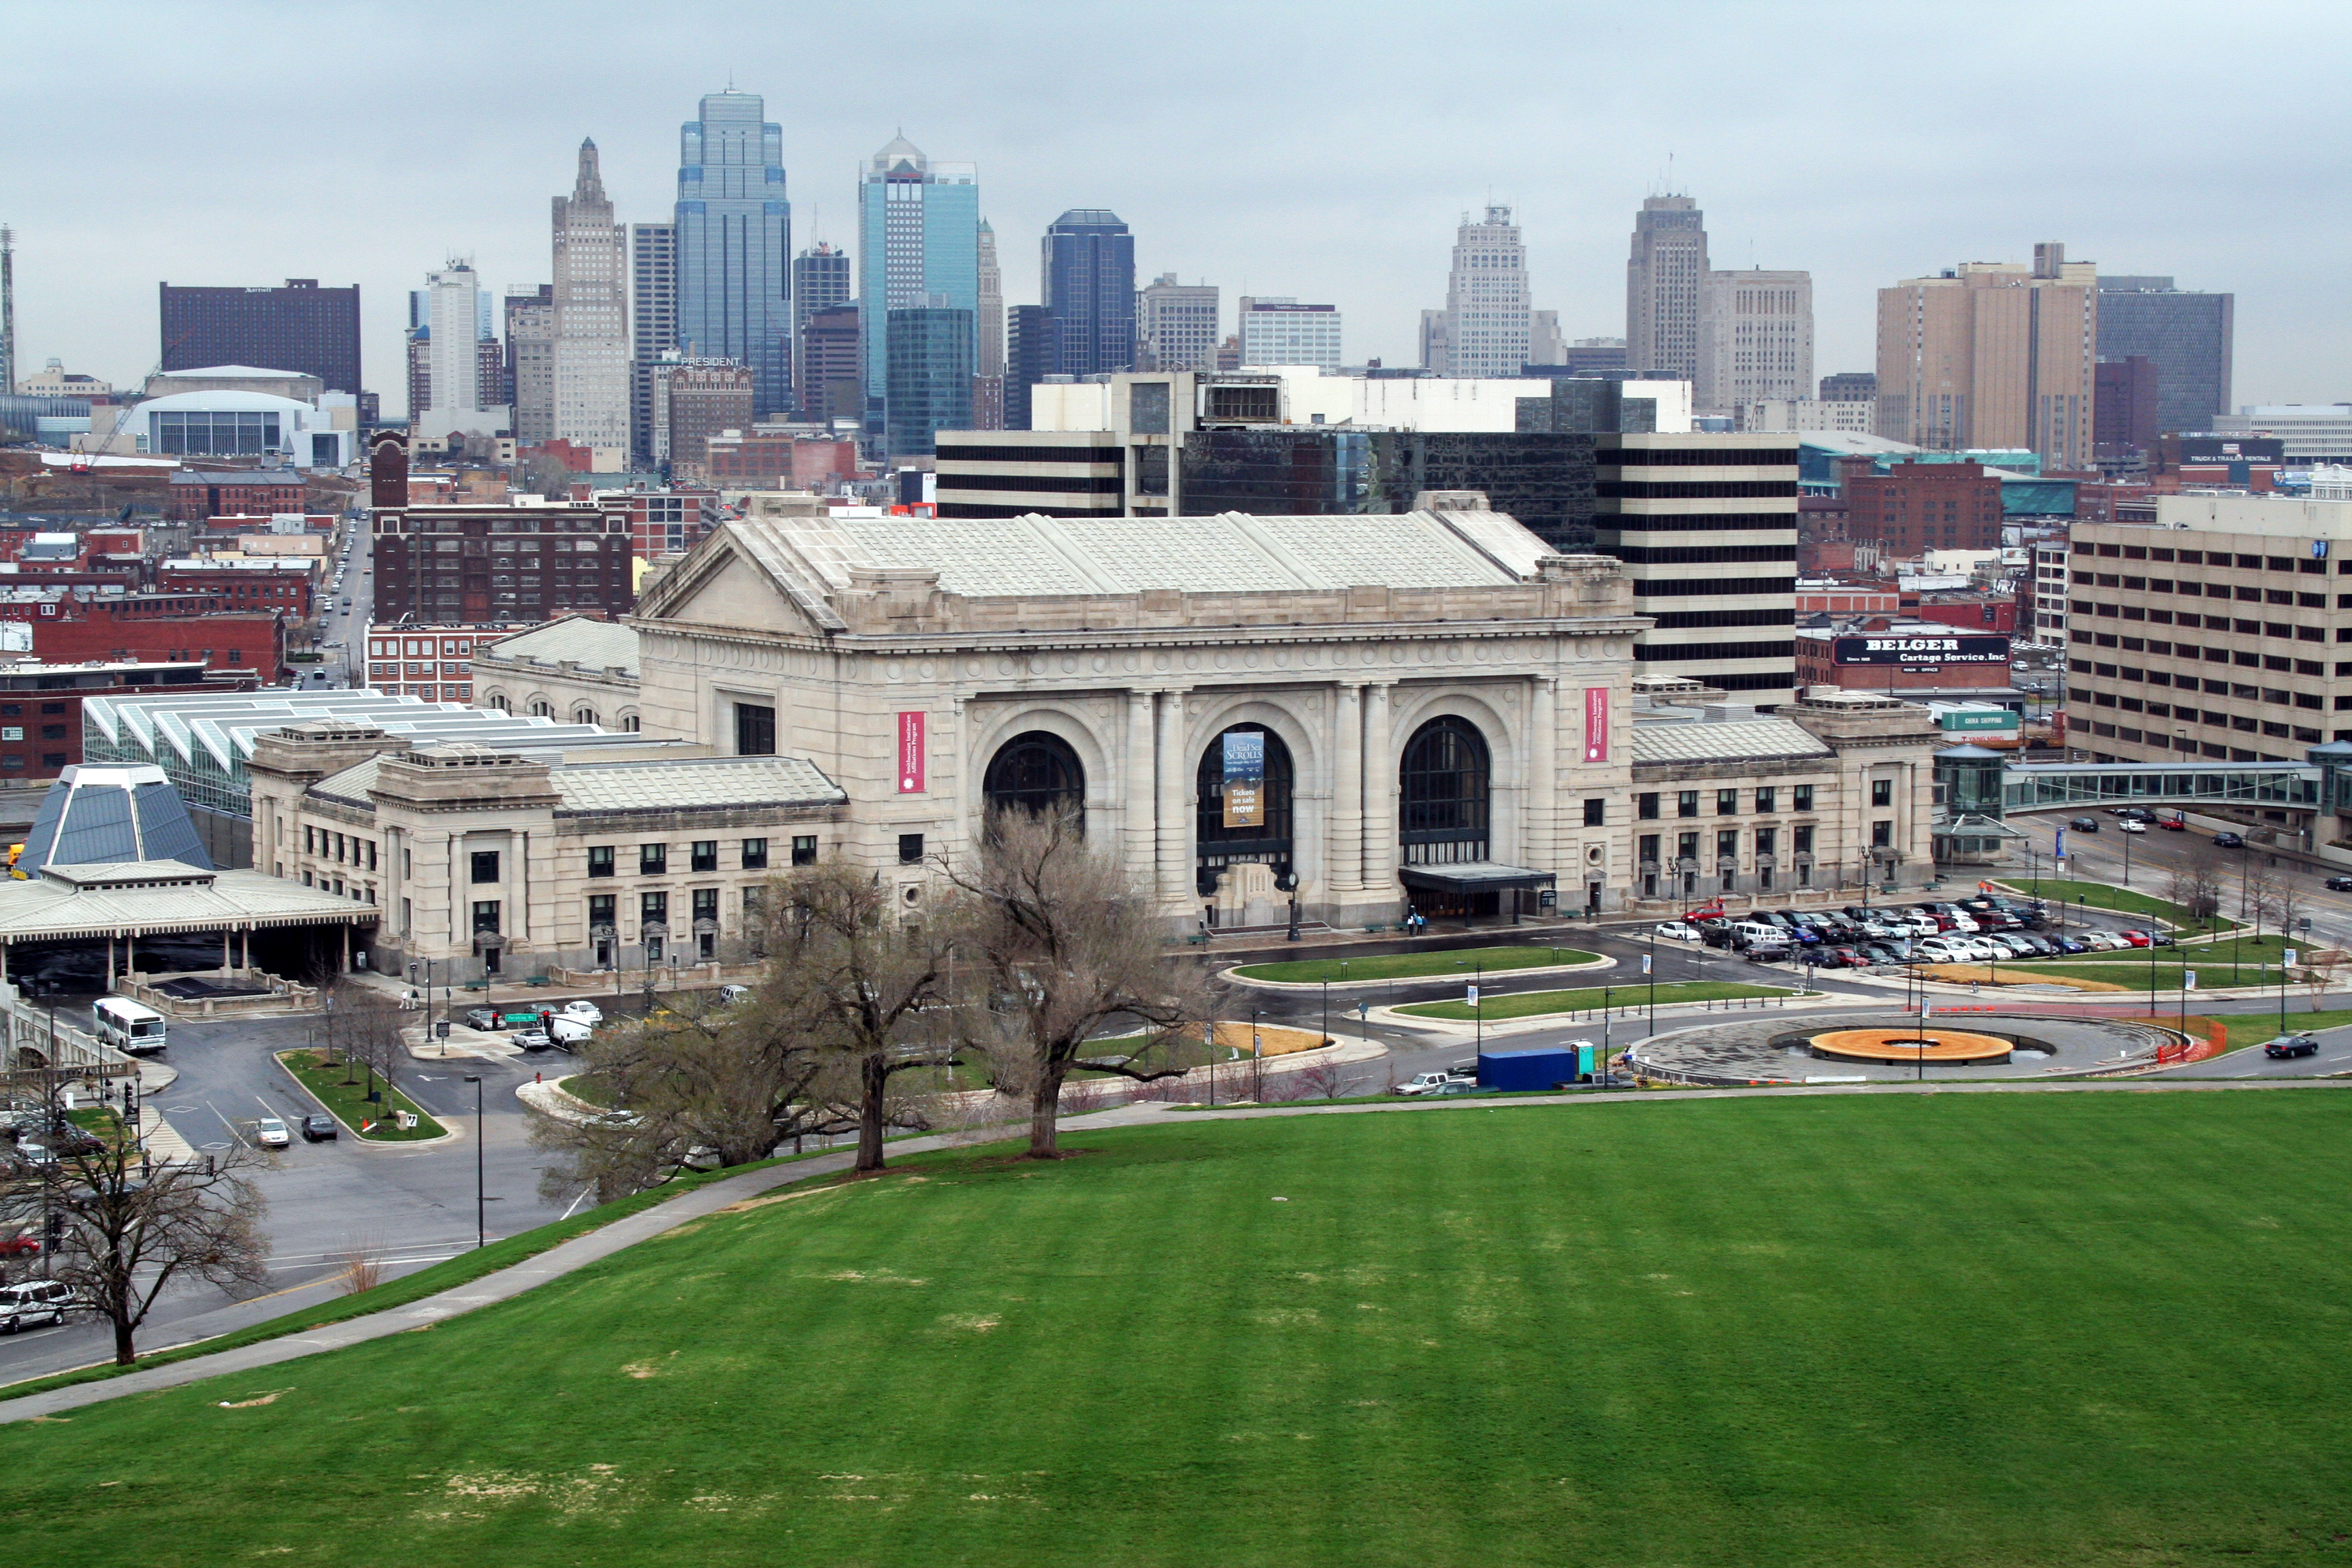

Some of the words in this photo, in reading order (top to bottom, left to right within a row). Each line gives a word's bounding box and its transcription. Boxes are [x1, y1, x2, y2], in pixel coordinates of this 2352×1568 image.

[681, 357, 740, 366] PRESIDENT
[1866, 639, 1959, 651] BELGER
[1899, 653, 1942, 663] Cartage
[1988, 653, 2007, 661] Inc.
[1232, 743, 1250, 751] Dead
[1251, 742, 1262, 751] Sea
[1232, 805, 1254, 813] now
